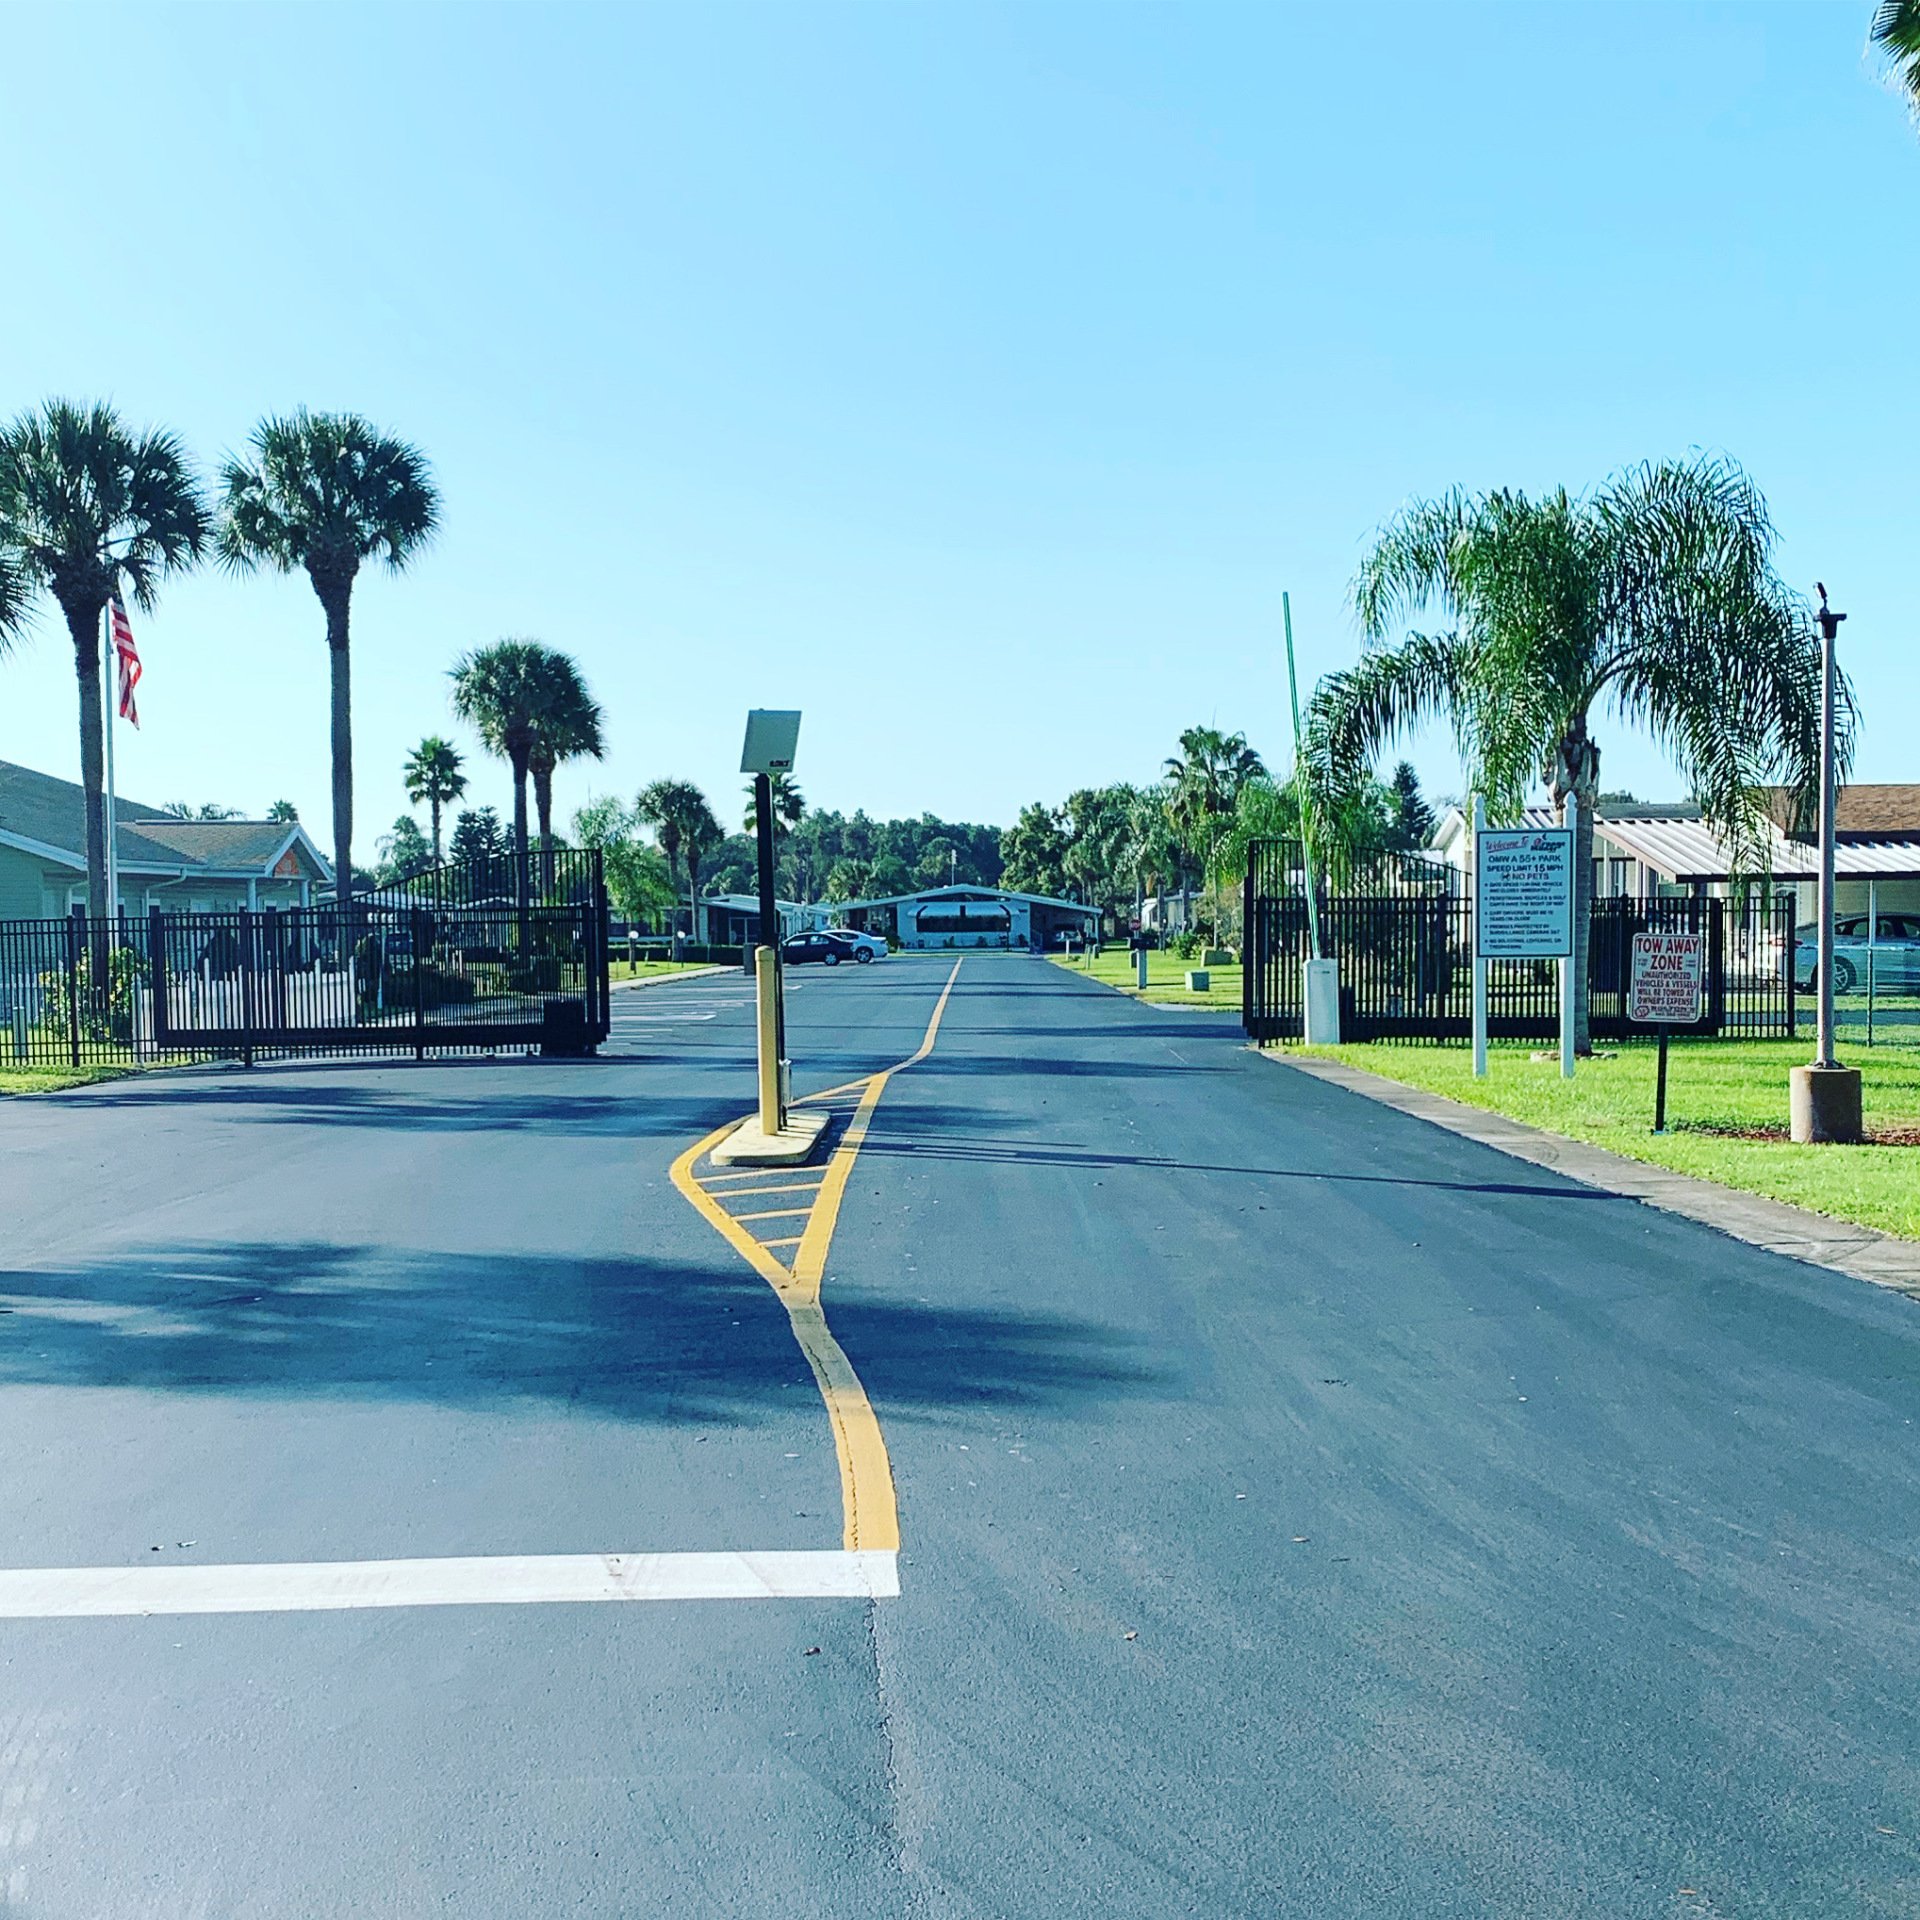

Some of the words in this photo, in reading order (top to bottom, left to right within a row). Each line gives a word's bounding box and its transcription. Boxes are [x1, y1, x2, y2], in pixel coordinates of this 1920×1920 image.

[1511, 855, 1517, 863] A
[1519, 855, 1536, 863] 55+
[1534, 864, 1545, 872] 15
[1636, 938, 1663, 953] TOW
[1665, 938, 1699, 954] AWAY
[1650, 954, 1683, 970] ZONE
[1636, 979, 1664, 988] VEHICLES
[1637, 988, 1651, 996] WILL
[1653, 988, 1661, 996] BE
[1663, 989, 1684, 997] TOWED
[1686, 989, 1694, 997] AT
[1666, 997, 1694, 1006] EXPENSE
